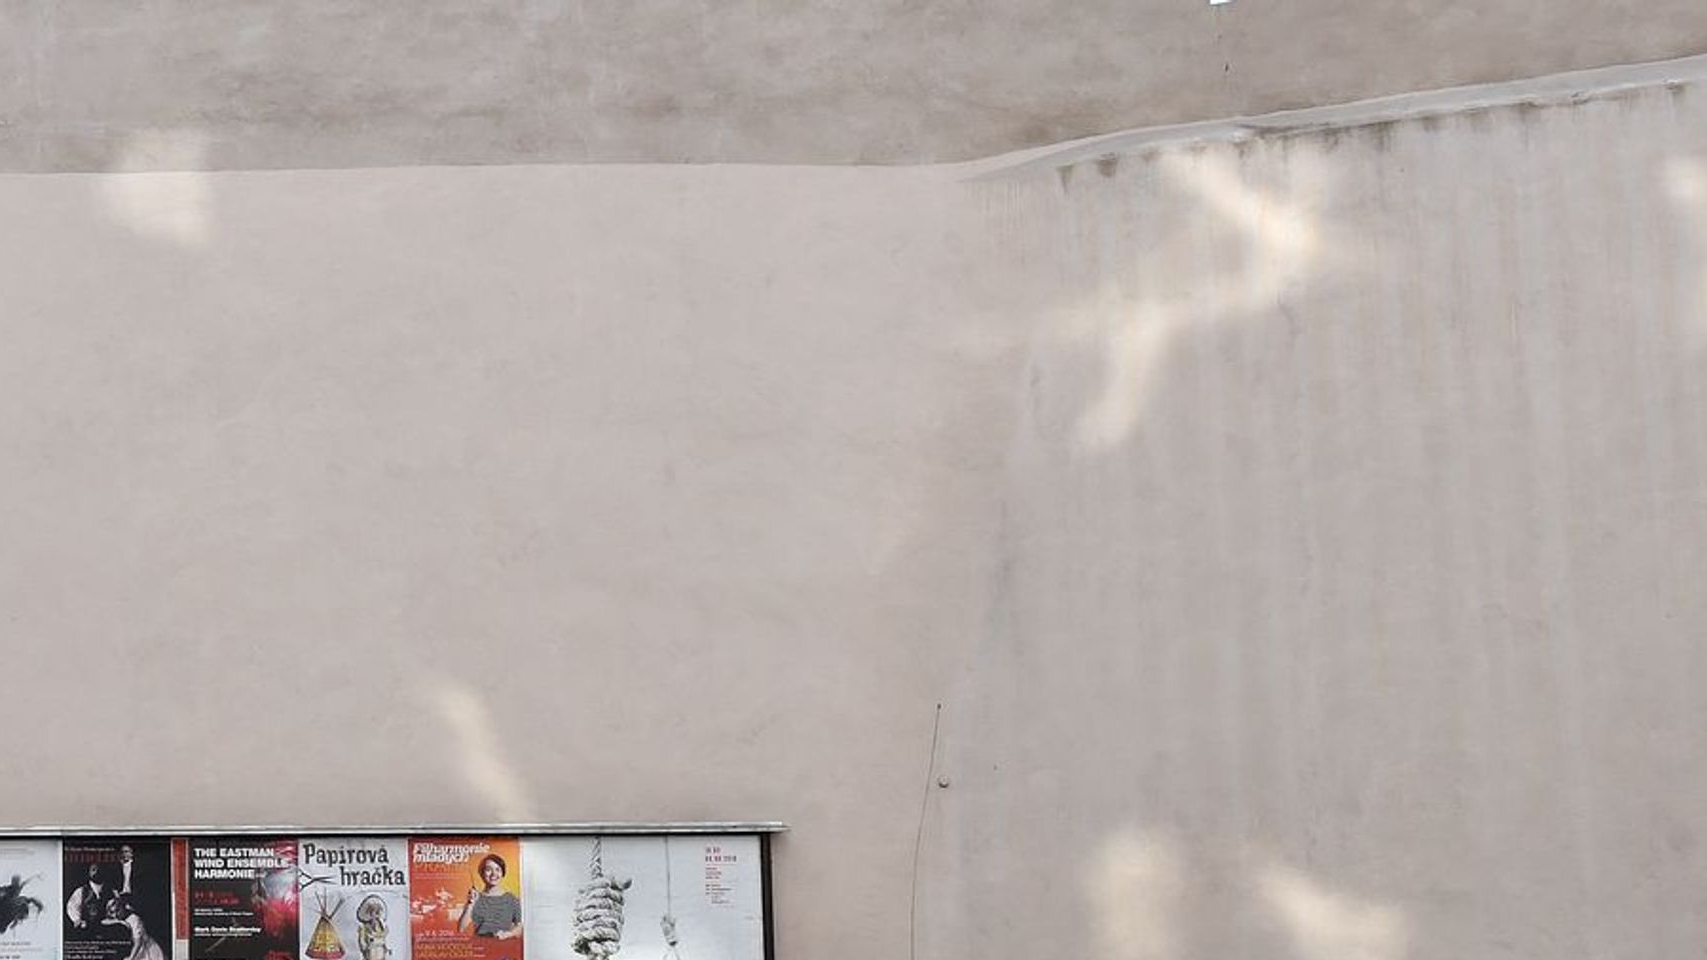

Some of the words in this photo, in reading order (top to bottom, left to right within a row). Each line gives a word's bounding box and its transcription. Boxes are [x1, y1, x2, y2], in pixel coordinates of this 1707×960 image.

[194, 848, 216, 857] THE
[220, 848, 274, 857] EASTMAN
[303, 843, 390, 867] Papírová
[194, 859, 224, 868] WIND
[194, 869, 255, 879] HARMONIE
[340, 865, 406, 887] hračka
